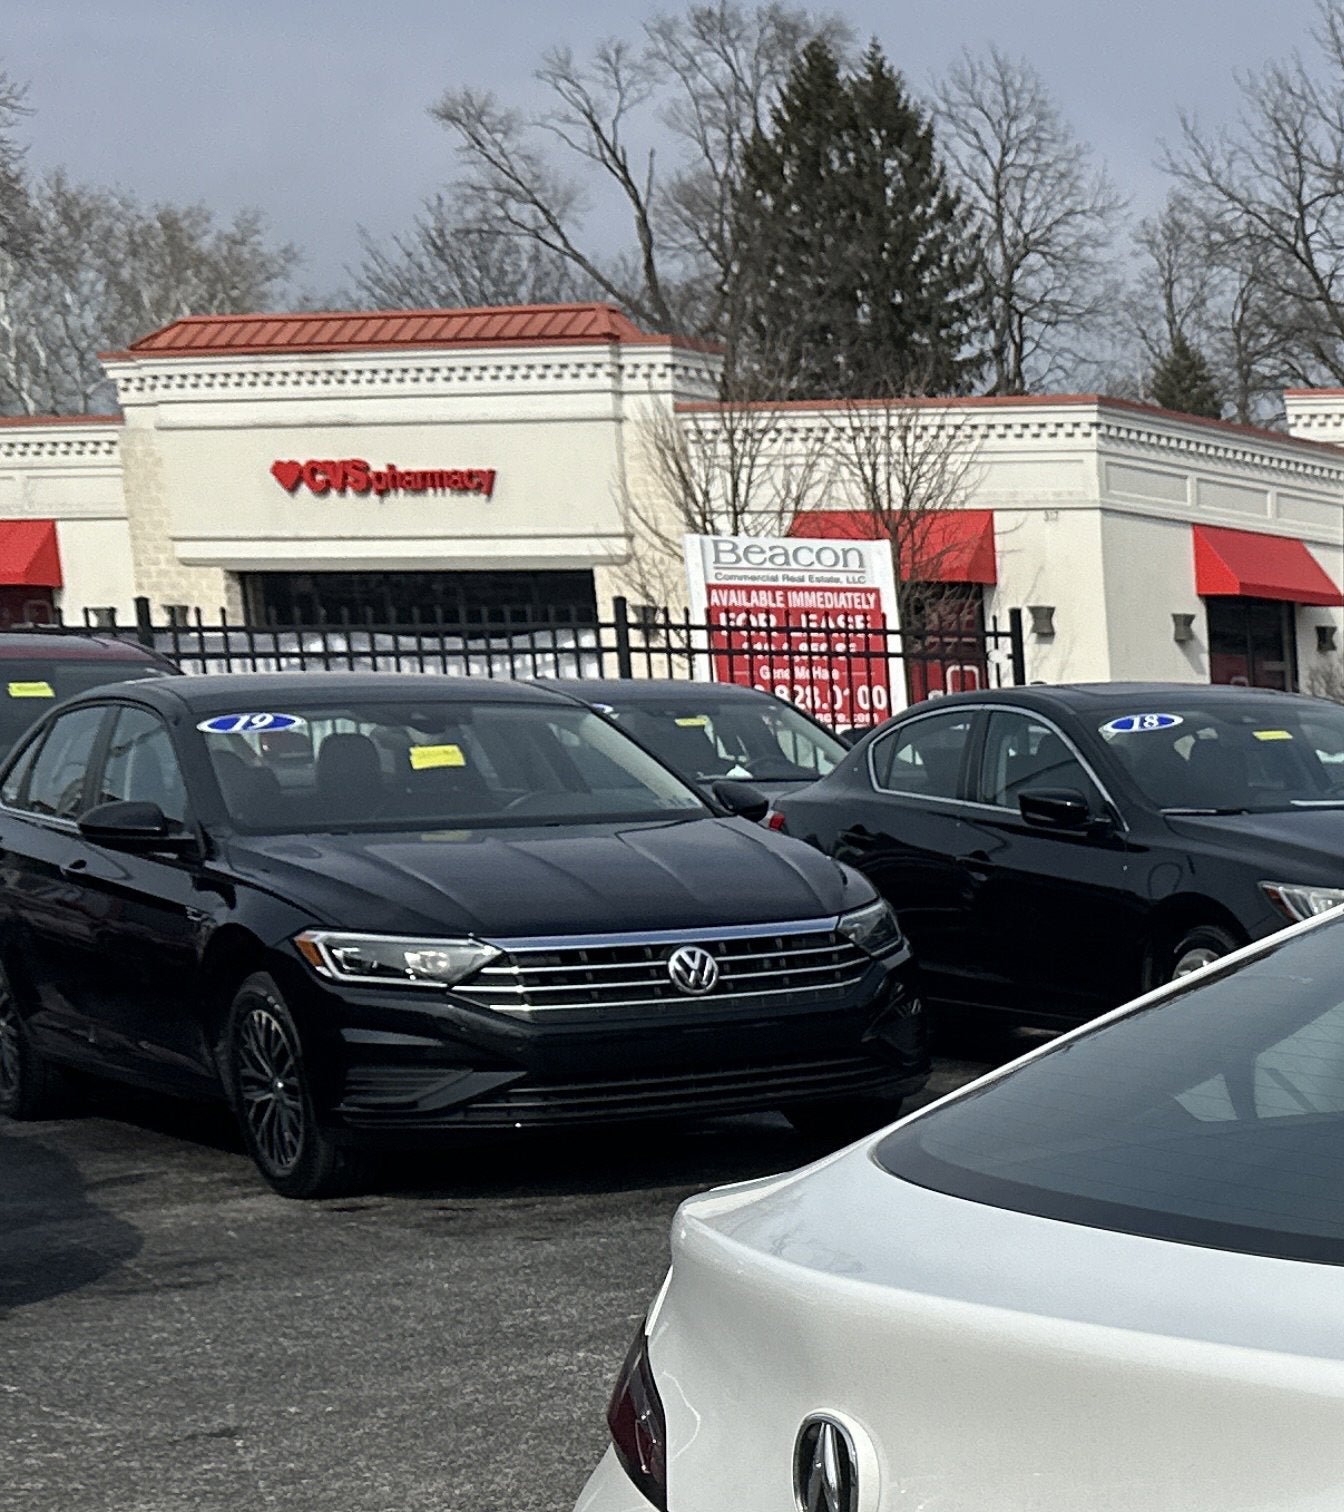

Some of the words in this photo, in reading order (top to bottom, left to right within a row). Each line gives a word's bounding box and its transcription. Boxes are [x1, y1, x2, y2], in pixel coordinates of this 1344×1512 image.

[711, 539, 865, 569] Beacon
[714, 572, 779, 583] Commercial
[782, 573, 805, 583] Real
[846, 575, 867, 584] LLC
[710, 588, 785, 608] AVAILABLE
[788, 591, 876, 609] IMMEDIATELY
[231, 713, 275, 732] 19
[1132, 714, 1159, 731] 18
